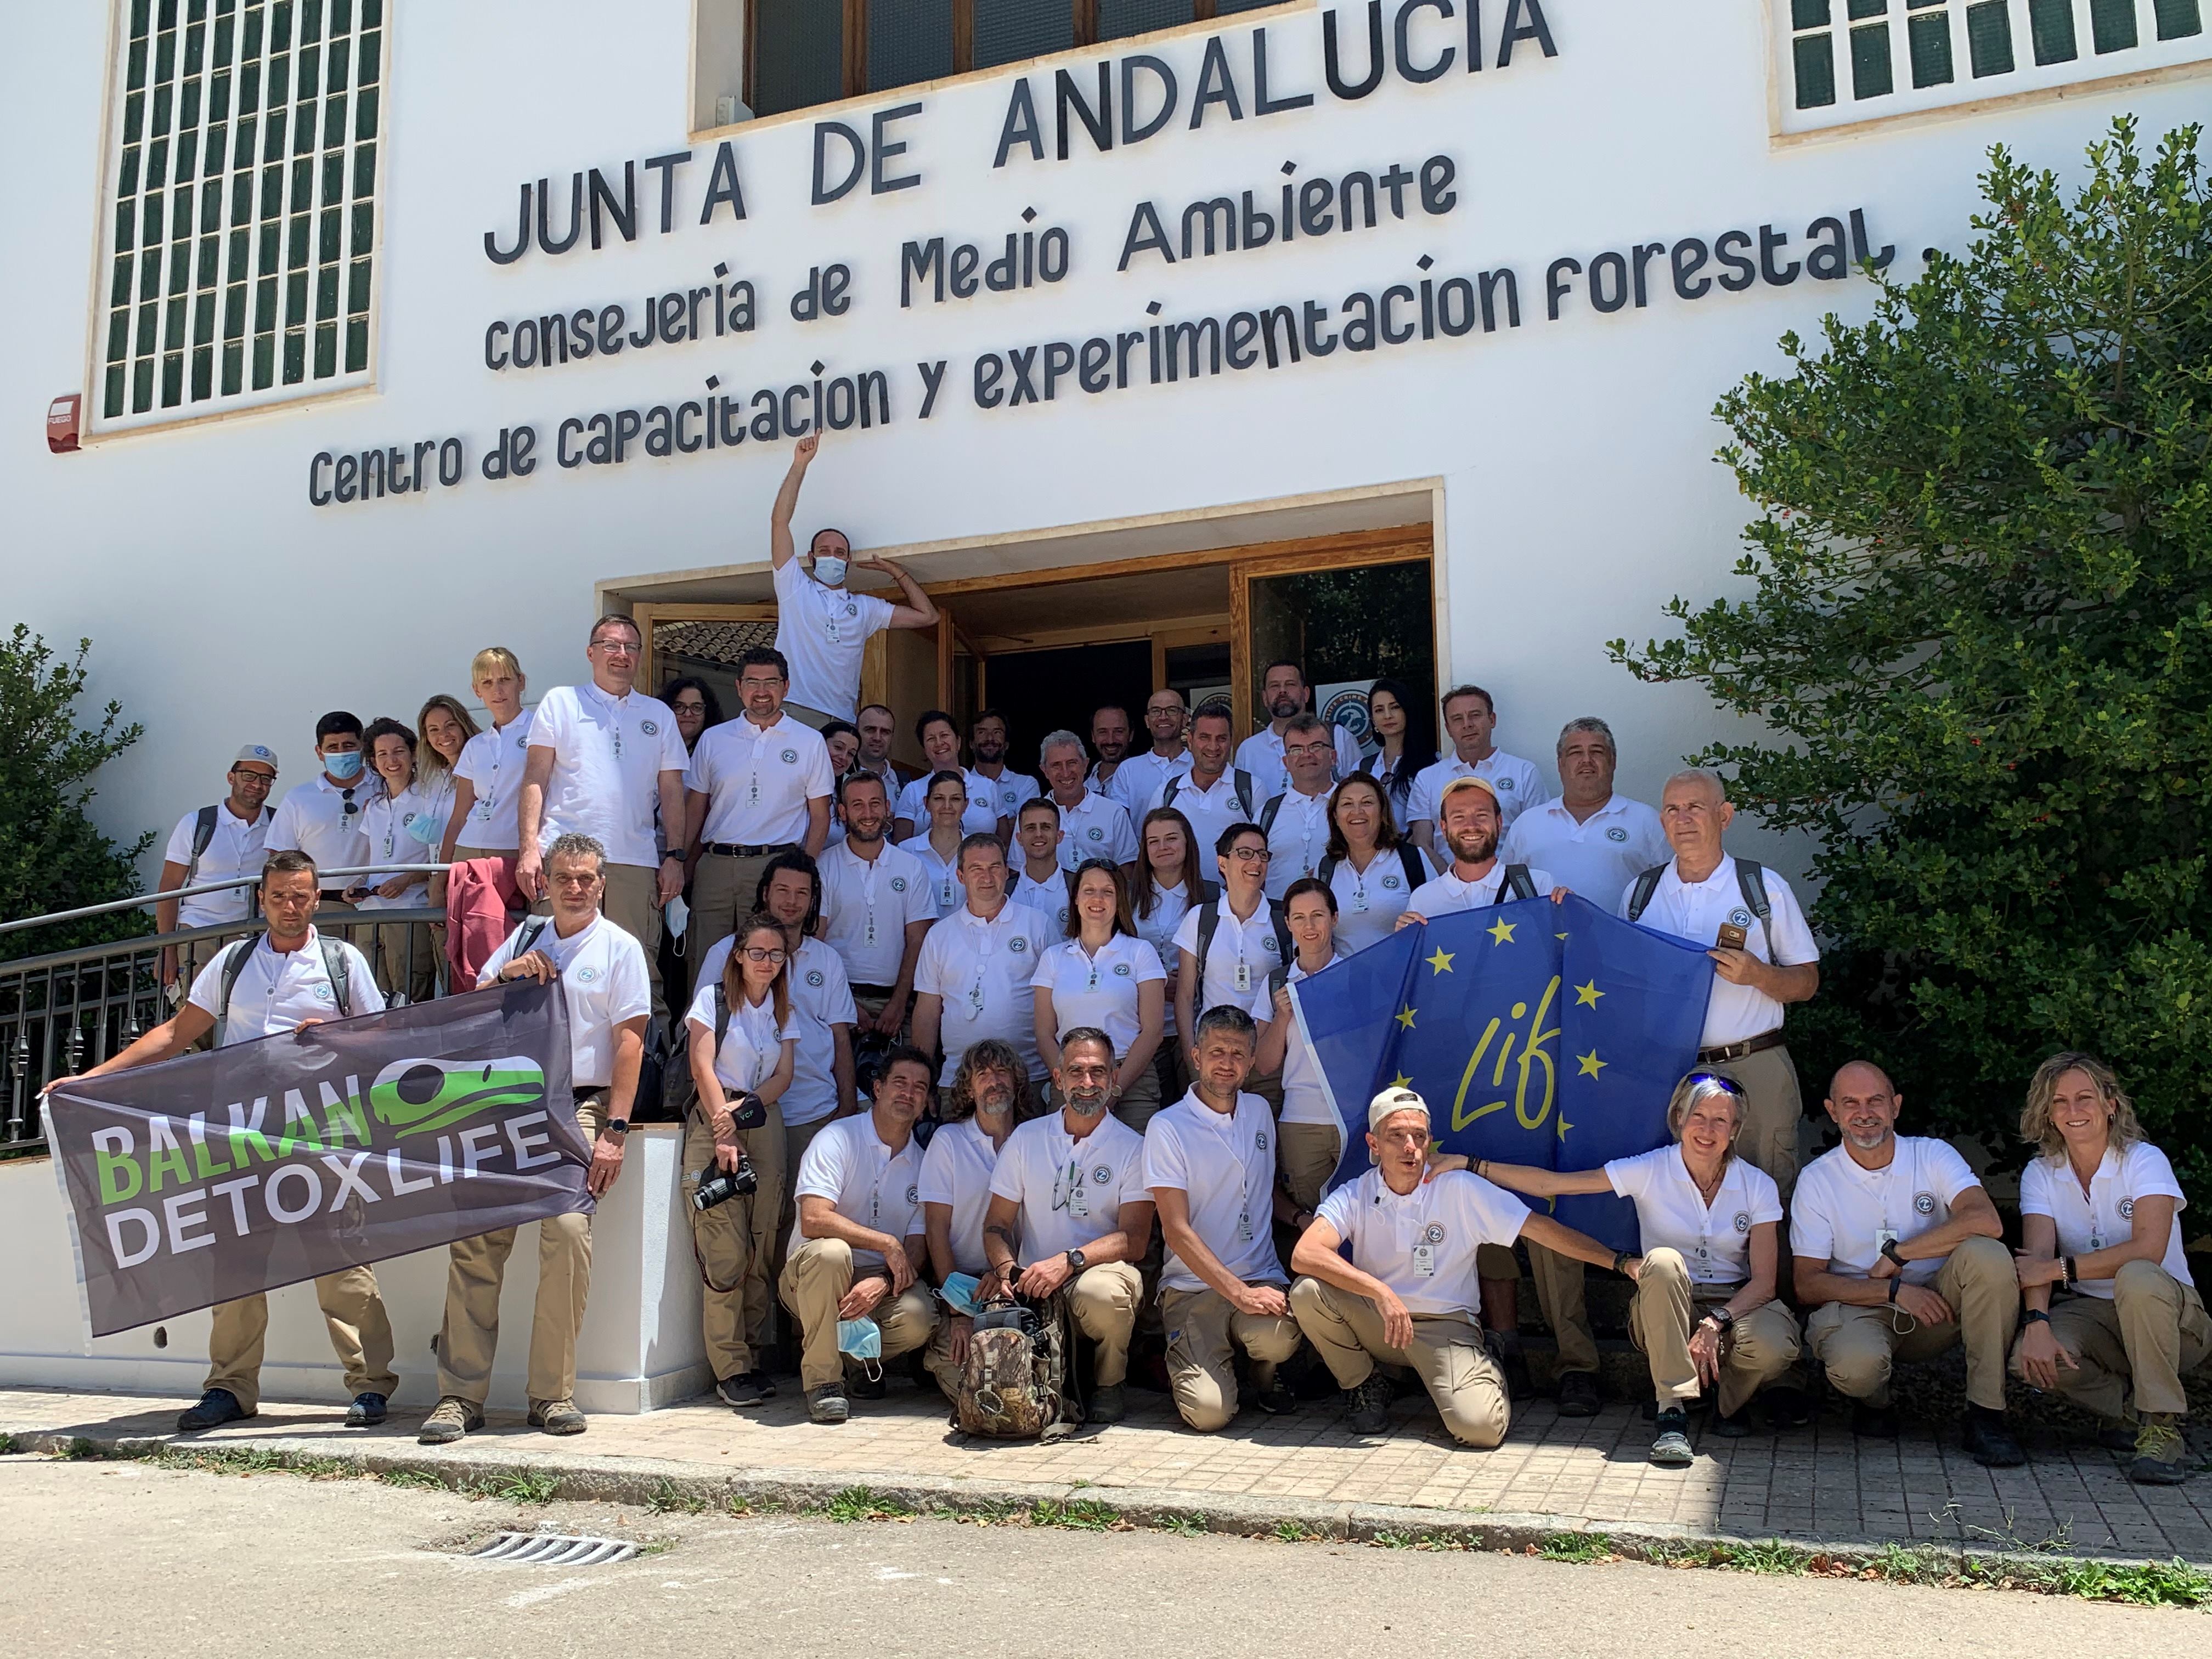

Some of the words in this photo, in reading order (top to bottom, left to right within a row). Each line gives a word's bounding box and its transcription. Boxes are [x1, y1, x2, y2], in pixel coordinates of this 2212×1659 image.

[484, 141, 747, 265] JUNTA
[811, 102, 922, 206] DE
[992, 0, 1559, 168] ANDALUCIA
[790, 263, 851, 322] de
[900, 206, 1069, 308] Medio
[1117, 155, 1457, 272] Ambiente
[48, 415, 71, 425] FUEGO
[309, 437, 462, 506] Centro
[482, 426, 537, 480] de
[740, 1109, 754, 1121] VCF
[1451, 975, 1561, 1132] Lif
[91, 1074, 373, 1206] BALKAN
